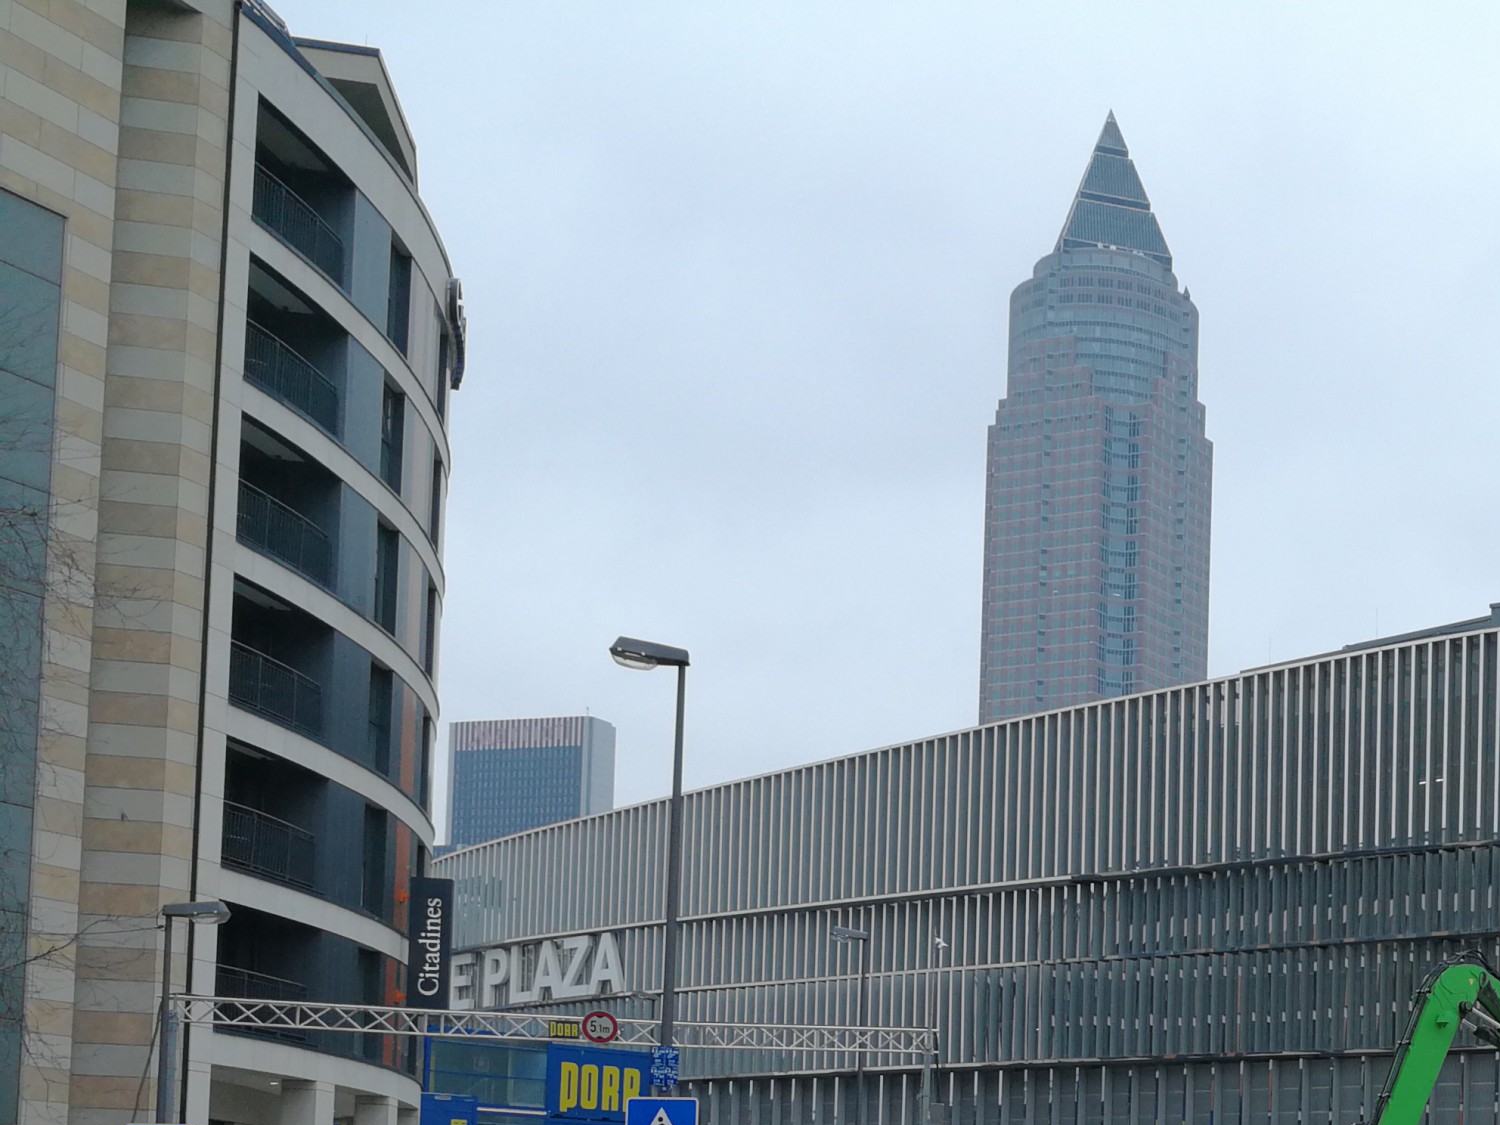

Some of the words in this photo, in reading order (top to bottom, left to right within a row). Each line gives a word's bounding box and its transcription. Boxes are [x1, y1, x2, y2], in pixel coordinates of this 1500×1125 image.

[417, 897, 442, 996] Citadines
[483, 932, 625, 1008] PLAZA
[550, 1021, 579, 1037] PORR
[559, 1061, 641, 1113] PORR
